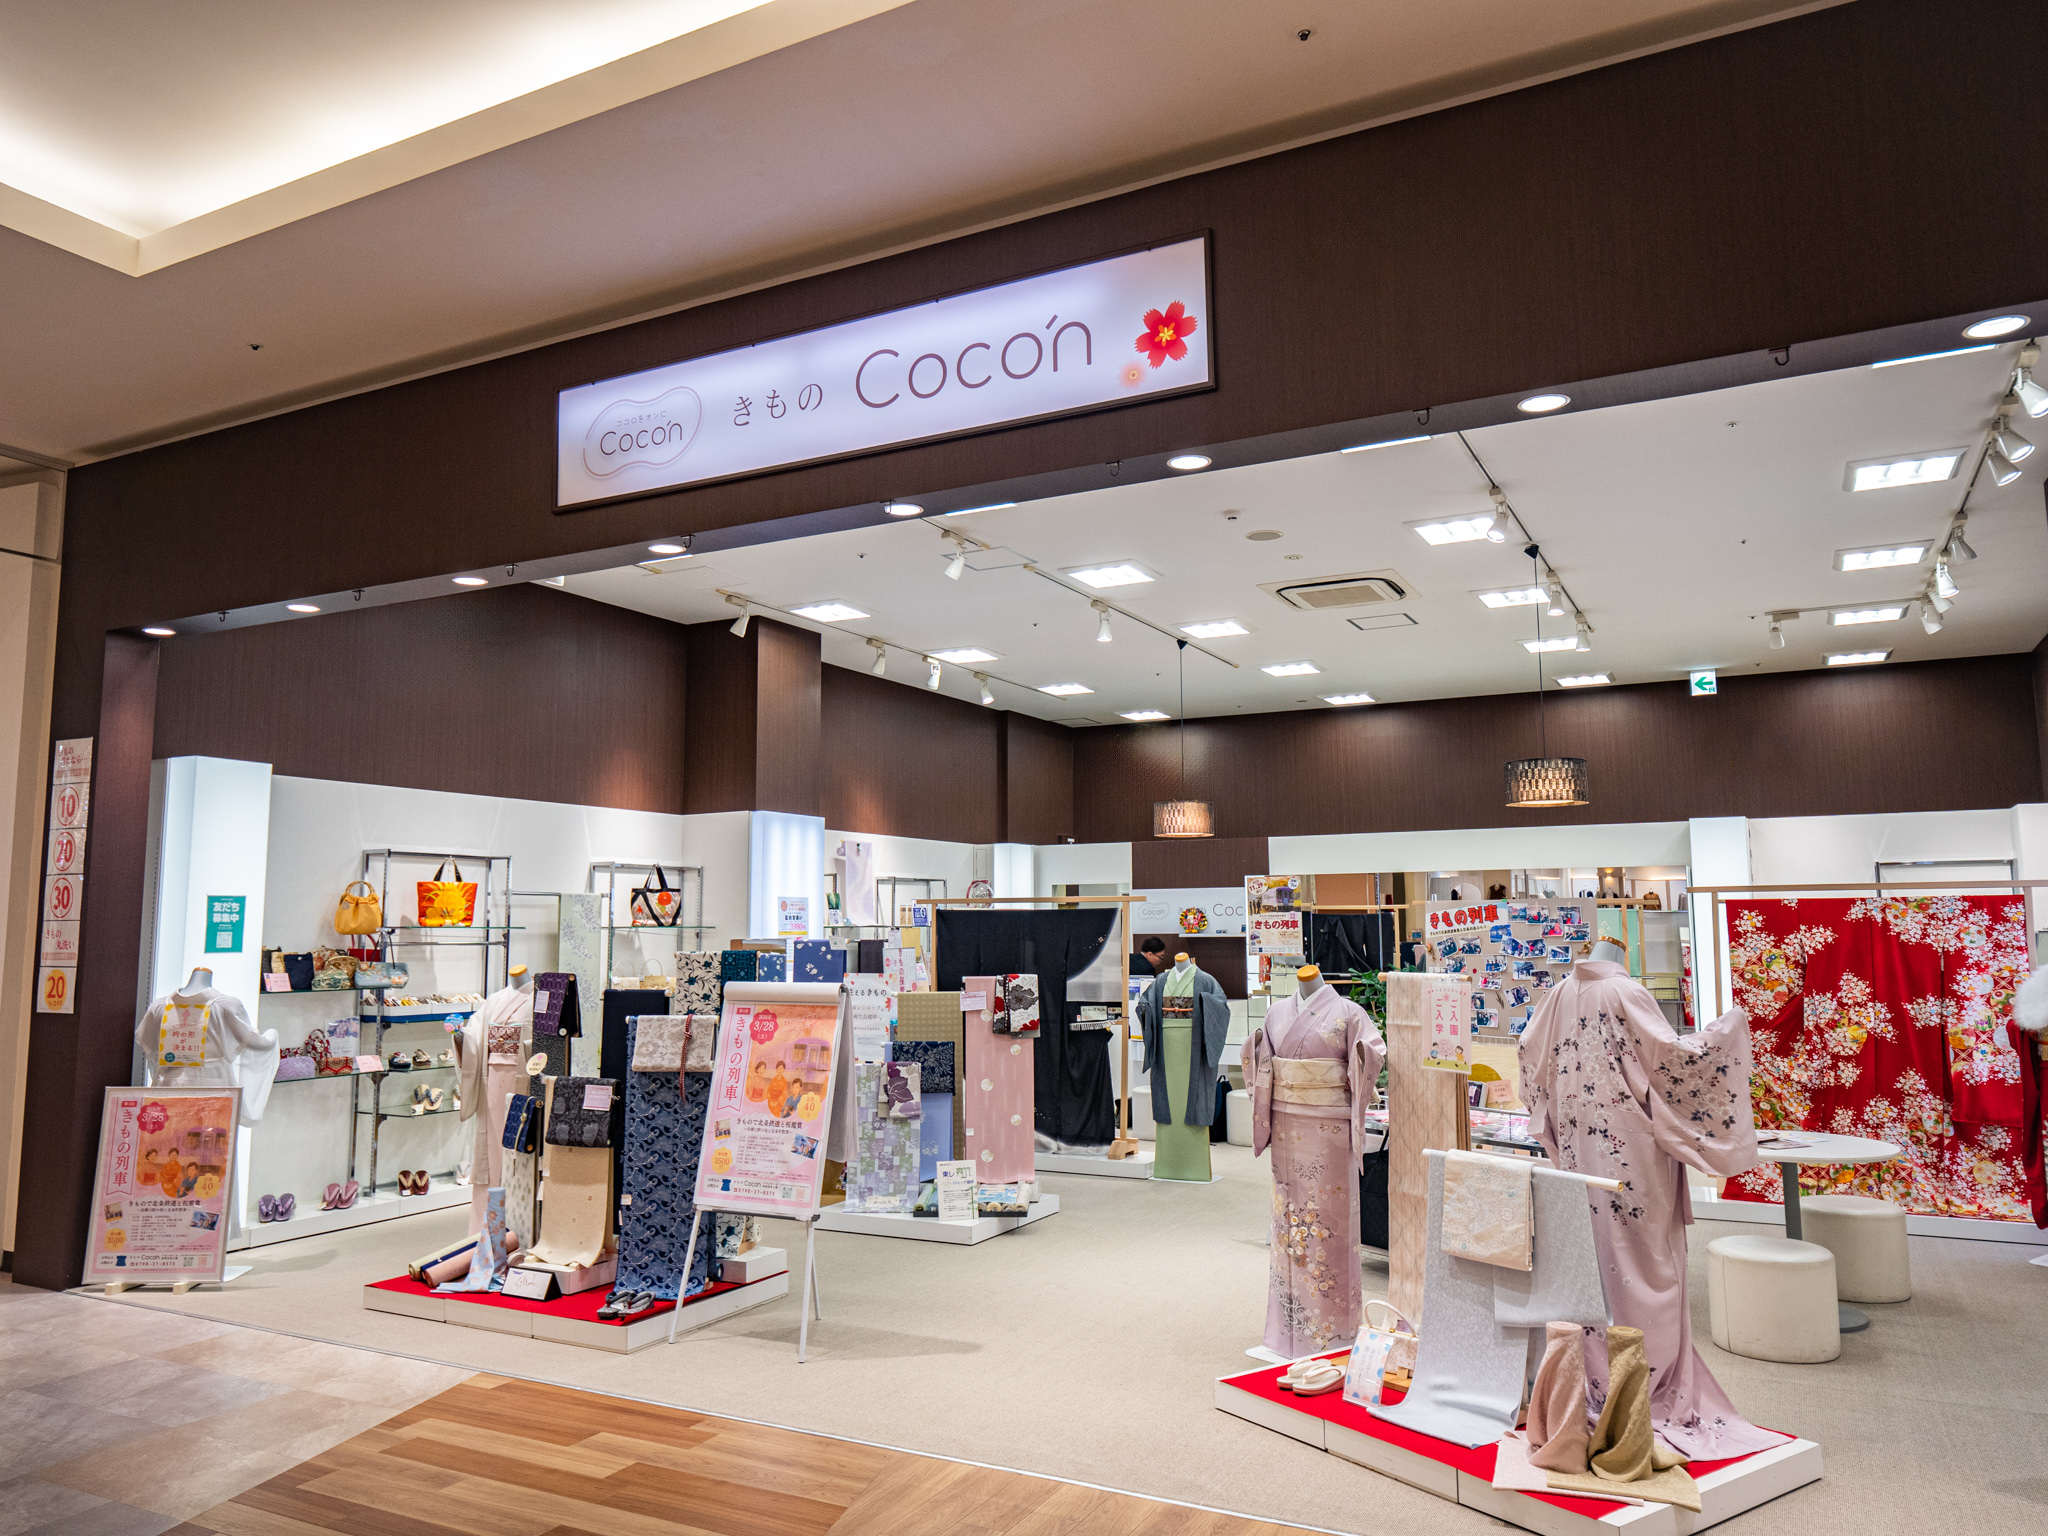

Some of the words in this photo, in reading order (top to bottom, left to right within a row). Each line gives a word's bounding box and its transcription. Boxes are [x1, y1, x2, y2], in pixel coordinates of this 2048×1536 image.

[733, 383, 823, 427] きもの
[616, 410, 667, 427] ココロをオンに
[60, 794, 76, 818] 10
[56, 839, 73, 863] 20
[1249, 882, 1264, 892] 11.29
[53, 885, 71, 910] 30
[213, 902, 240, 912] 友だち
[1212, 903, 1244, 917] Coc
[213, 912, 240, 923] 募集中
[1430, 904, 1499, 930] きもの列車
[1254, 919, 1299, 930] きもの列車
[45, 929, 62, 940] きもの
[56, 940, 75, 951] 丸洗い
[46, 976, 66, 999] 20
[1435, 998, 1444, 1035] ご入学
[1449, 999, 1459, 1036] ご入園
[753, 1020, 775, 1032] 3/28
[172, 1031, 196, 1039] 衿の形
[724, 1016, 746, 1102] きもの列車
[804, 1102, 815, 1112] 40
[141, 1111, 165, 1123] 3/28
[112, 1109, 133, 1187] きもの列車
[713, 1156, 730, 1166] 3500
[942, 1170, 955, 1178] 東レ
[201, 1182, 214, 1191] 40
[106, 1236, 124, 1244] 3500
